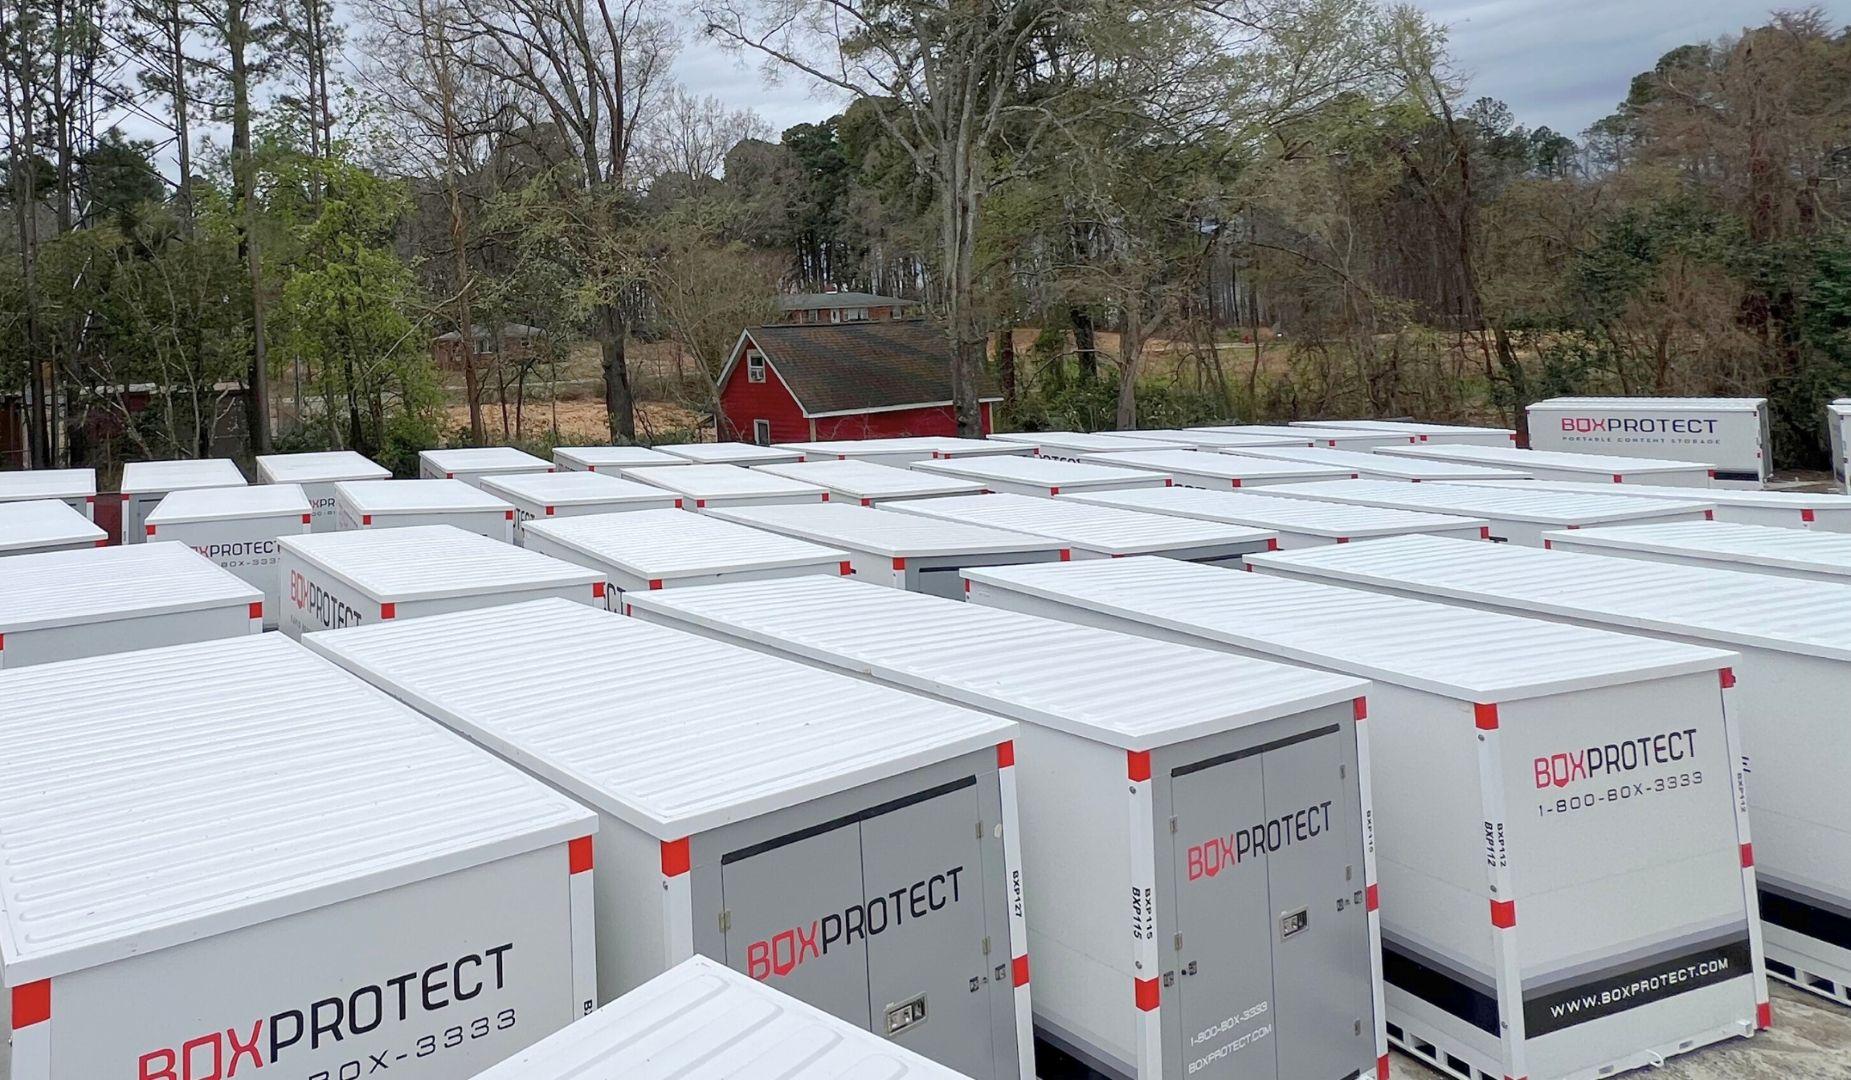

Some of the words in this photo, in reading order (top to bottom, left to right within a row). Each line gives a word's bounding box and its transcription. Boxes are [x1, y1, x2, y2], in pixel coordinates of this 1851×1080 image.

[1561, 417, 1718, 434] BOXPROTECT
[1534, 728, 1697, 789] BOXPROTECT
[1538, 770, 1704, 817] 1-800-BOX-3333
[1187, 800, 1333, 881] BOXPROTECT
[1484, 820, 1496, 867] BXP112
[1496, 822, 1507, 868] BXP112
[1011, 869, 1023, 919] BXP127
[1132, 886, 1142, 940] BXP115
[1144, 887, 1154, 940] BXP115
[746, 866, 964, 981] BOXPROTECT
[137, 942, 513, 1080] BOXPROTECT
[1549, 957, 1729, 1018] WWW.BOXPROTECT.COM
[1188, 1023, 1273, 1075] BOXPROTECT.COM
[1190, 1001, 1269, 1046] 1-800-BOX-3333
